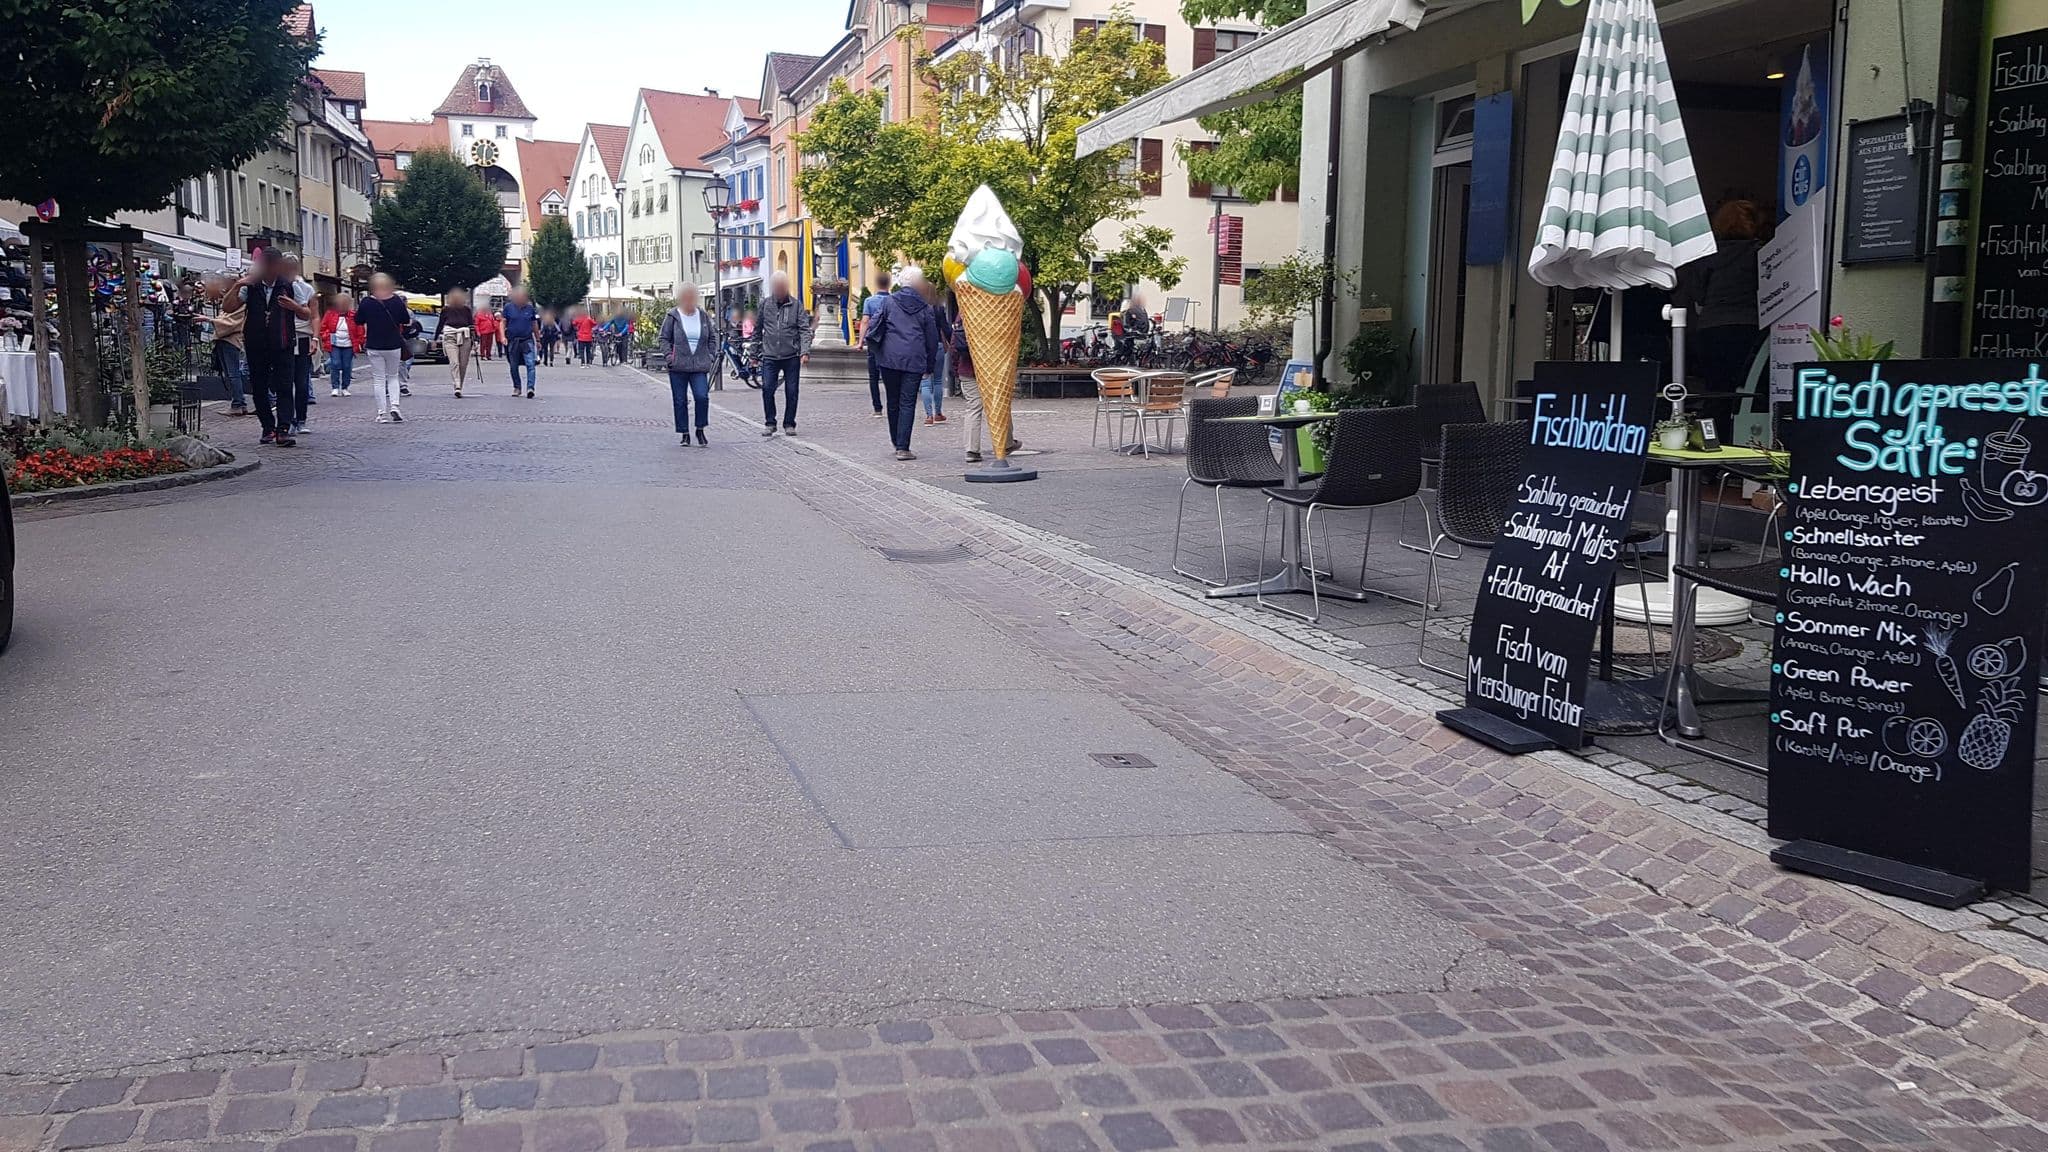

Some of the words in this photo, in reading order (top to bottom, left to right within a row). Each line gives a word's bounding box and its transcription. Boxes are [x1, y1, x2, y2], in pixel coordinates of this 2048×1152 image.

[1995, 45, 2048, 87] Fischb
[2018, 268, 2041, 278] vom
[1982, 289, 2034, 319] Felchen
[1797, 363, 1891, 420] Frisch
[1531, 393, 1646, 455] Fischbrötchen
[1519, 474, 1567, 515] Saibling
[1563, 486, 1631, 520] geräuchert
[1800, 475, 1944, 516] Lebensgeist
[1504, 512, 1548, 550] Saibling
[1546, 520, 1572, 548] nach
[1571, 521, 1619, 564] Matjes
[1792, 525, 1926, 547] Schnellstarter
[1541, 550, 1570, 581] Art
[1790, 564, 1841, 587] Hallo
[1847, 573, 1911, 597] Wach
[1490, 565, 1535, 602] Felchen
[1529, 583, 1601, 620] geräuchert
[1785, 611, 1871, 637] Sommer
[1876, 620, 1917, 646] Mix
[1905, 603, 1968, 630] Orange)
[1496, 623, 1532, 663] Fisch
[1536, 646, 1567, 678] vom
[1468, 654, 1541, 719] Meersburger
[1541, 676, 1584, 727] Fischer
[1783, 659, 1840, 683] Green
[1850, 666, 1913, 693] Power
[1780, 709, 1828, 735] Saft
[1837, 717, 1874, 738] Pur
